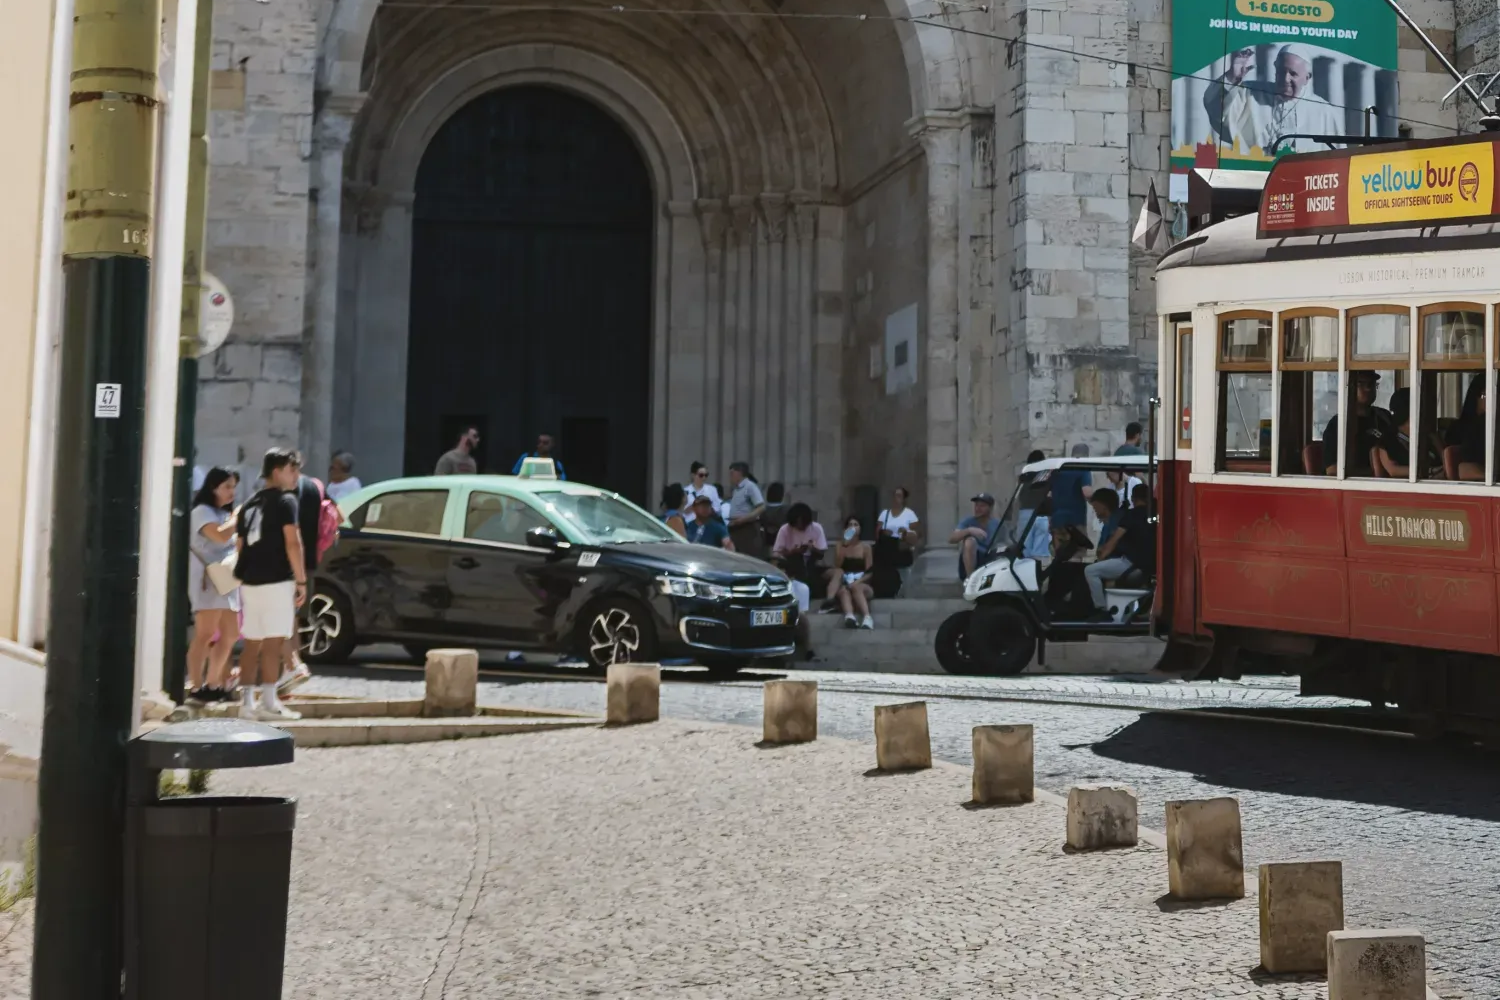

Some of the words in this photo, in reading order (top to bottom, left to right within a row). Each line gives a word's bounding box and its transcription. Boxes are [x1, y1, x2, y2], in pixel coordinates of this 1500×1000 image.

[1248, 1, 1268, 13] 1-6
[1270, 5, 1322, 18] AGOSTO
[1209, 18, 1233, 29] JOIN
[1234, 21, 1248, 31] US
[1249, 23, 1261, 32] IN
[1262, 24, 1300, 36] WORLD
[1301, 26, 1336, 38] YOUTH
[1337, 29, 1358, 40] DAY
[1304, 173, 1339, 191] TICKETS
[1361, 164, 1423, 194] yellow
[1426, 160, 1456, 188] bus
[1306, 196, 1335, 213] INSIDE
[1364, 198, 1390, 210] OFFICIAL
[1391, 195, 1431, 208] SIGHTSEEING
[1432, 193, 1454, 205] TOURS
[1368, 269, 1410, 281] HISTORICAL
[1415, 268, 1447, 280] PREMIUM
[1452, 266, 1485, 279] TRAMCAR
[1366, 514, 1394, 537] HILLS
[1395, 516, 1437, 540] TRAMCAR
[1438, 519, 1465, 542] TOUR
